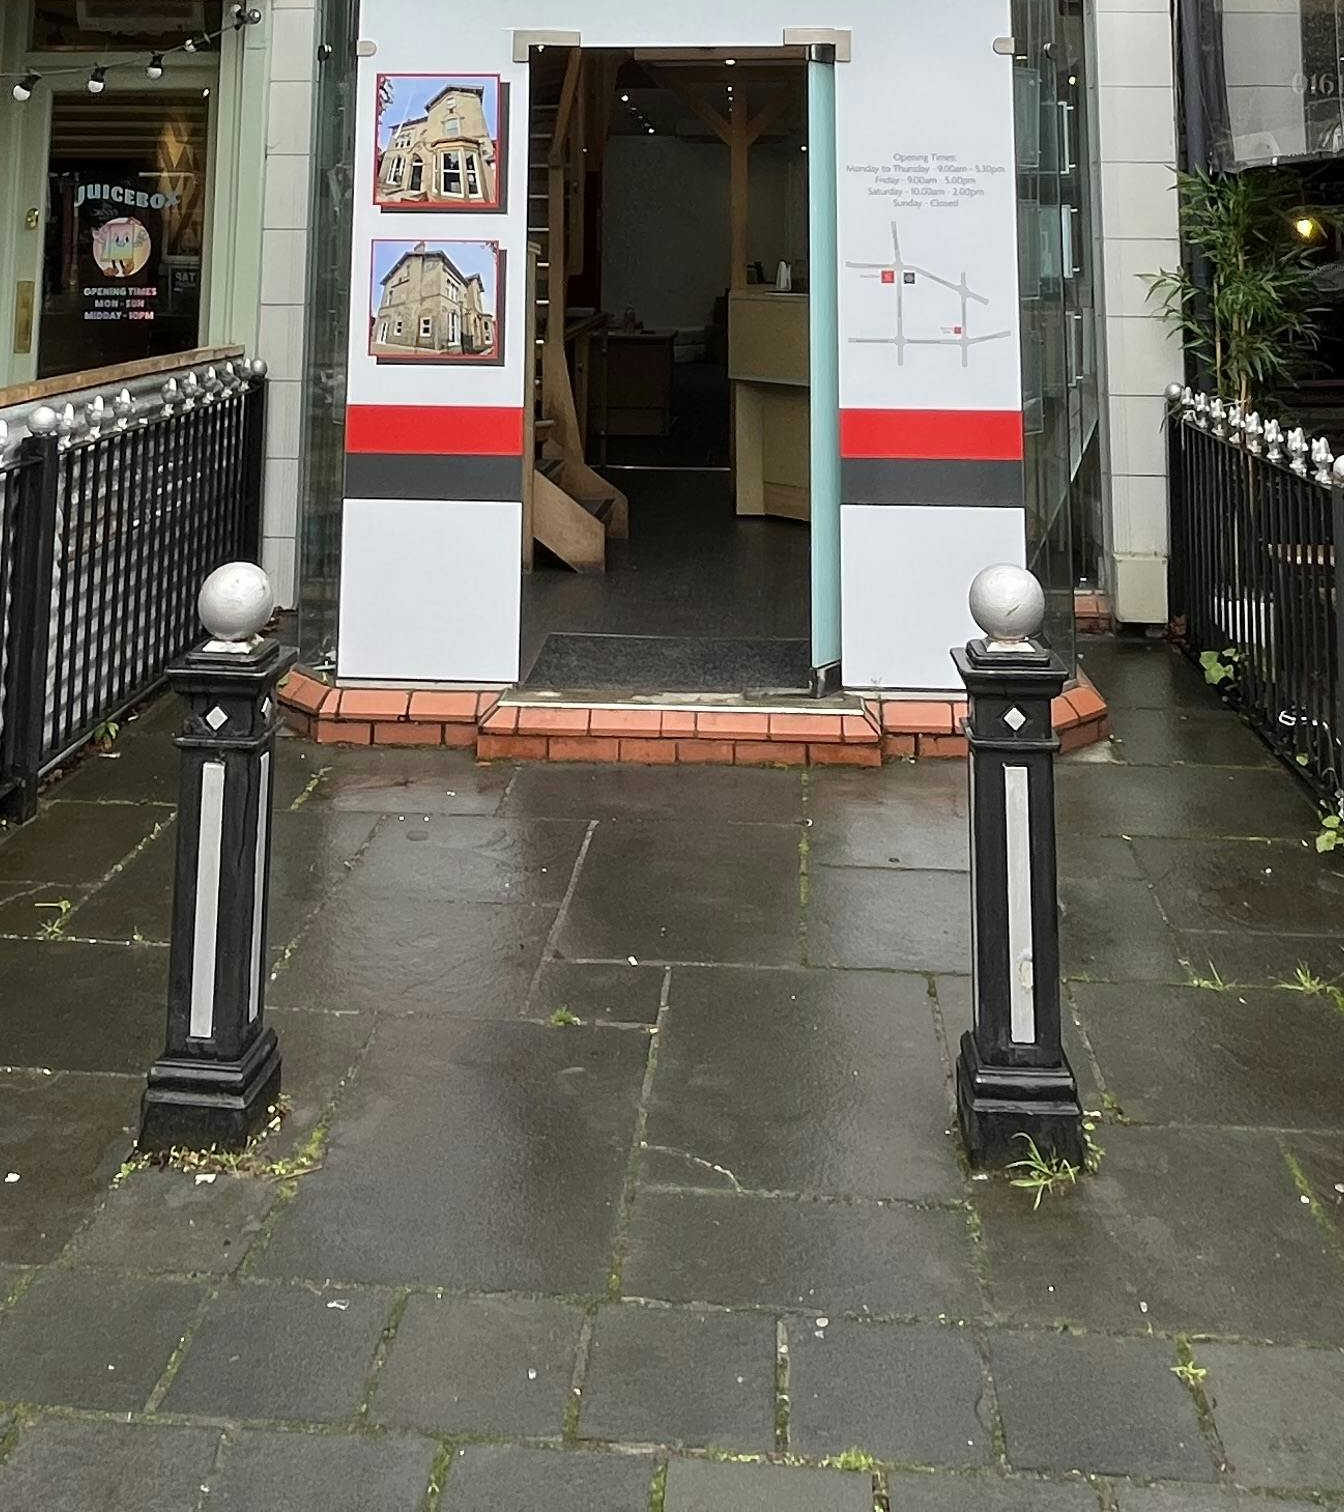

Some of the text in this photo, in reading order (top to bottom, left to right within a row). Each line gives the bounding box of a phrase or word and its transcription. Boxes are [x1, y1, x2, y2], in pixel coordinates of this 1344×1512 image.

[892, 152, 929, 164] Opening
[846, 165, 879, 174] Monday
[893, 164, 930, 174] Thursday
[874, 176, 900, 186] Friday
[74, 183, 181, 209] JUICEBOX
[867, 187, 903, 197] Saturday
[892, 199, 959, 209] Sunday Closed
[83, 288, 157, 296] OPENING TIMES
[94, 299, 145, 308] MON SUN
[84, 311, 123, 320] MIDDAY
